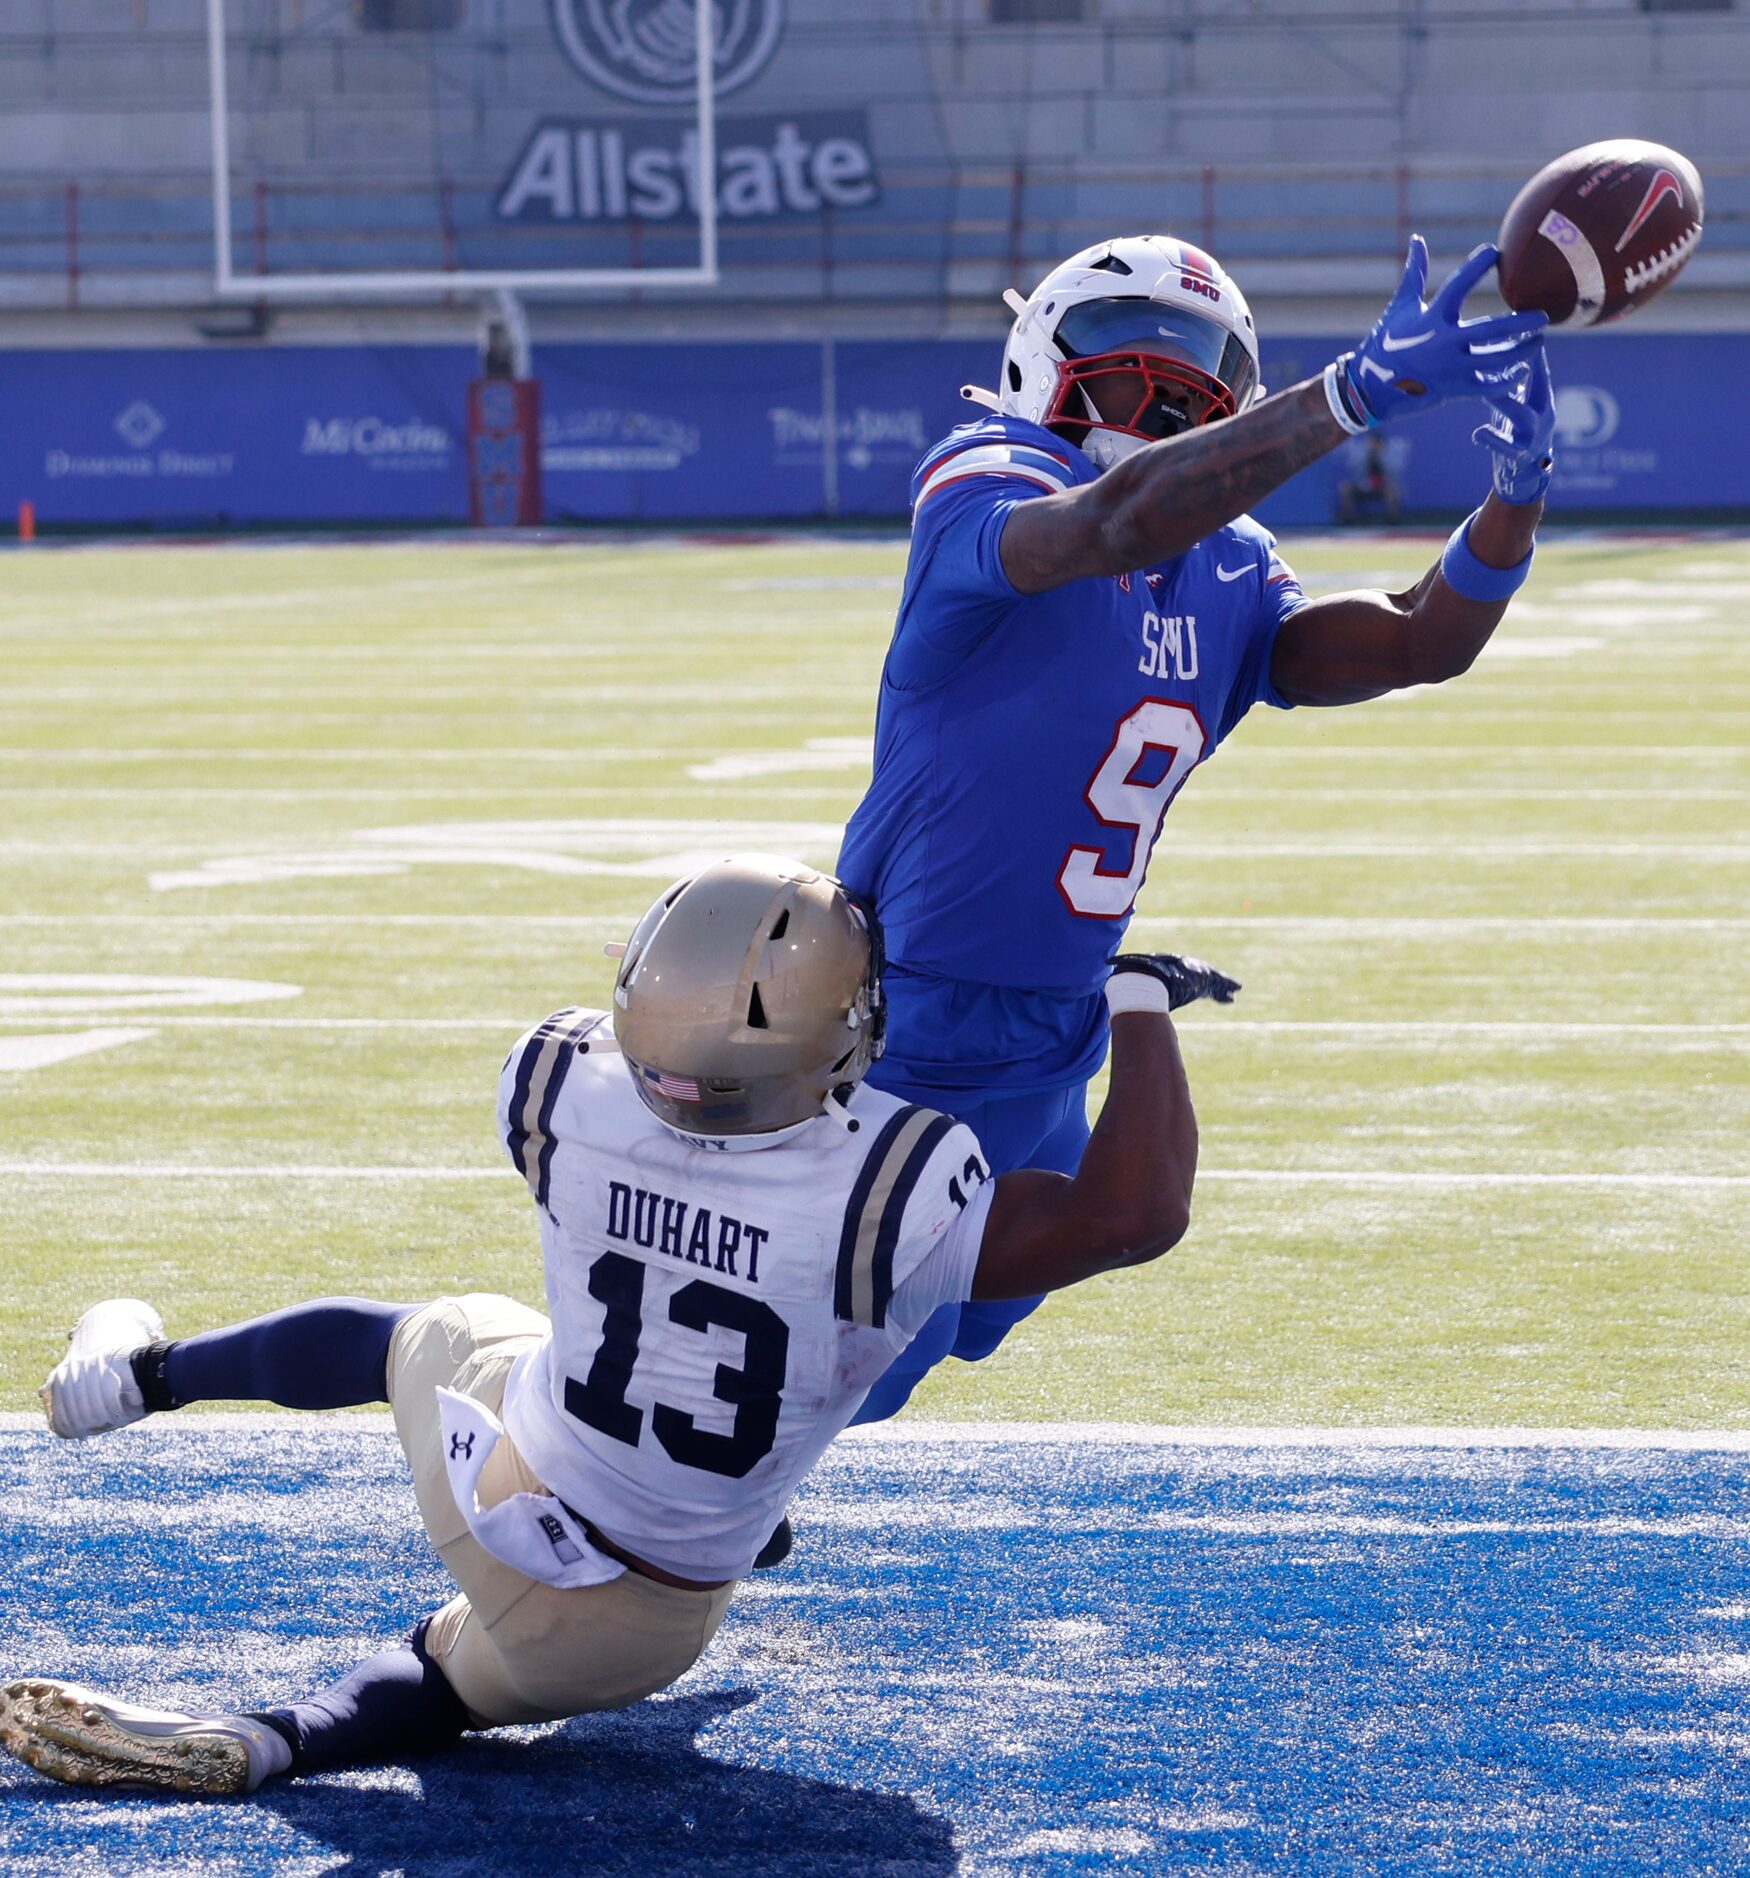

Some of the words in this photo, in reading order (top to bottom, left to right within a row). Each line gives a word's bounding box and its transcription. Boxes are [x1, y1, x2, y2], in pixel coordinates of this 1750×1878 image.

[500, 122, 875, 219] Allstate
[1180, 276, 1220, 302] SMU
[1138, 610, 1199, 680] SMU
[1056, 696, 1208, 920] 9
[606, 1180, 769, 1284] DUHART
[564, 1250, 790, 1479] 13
